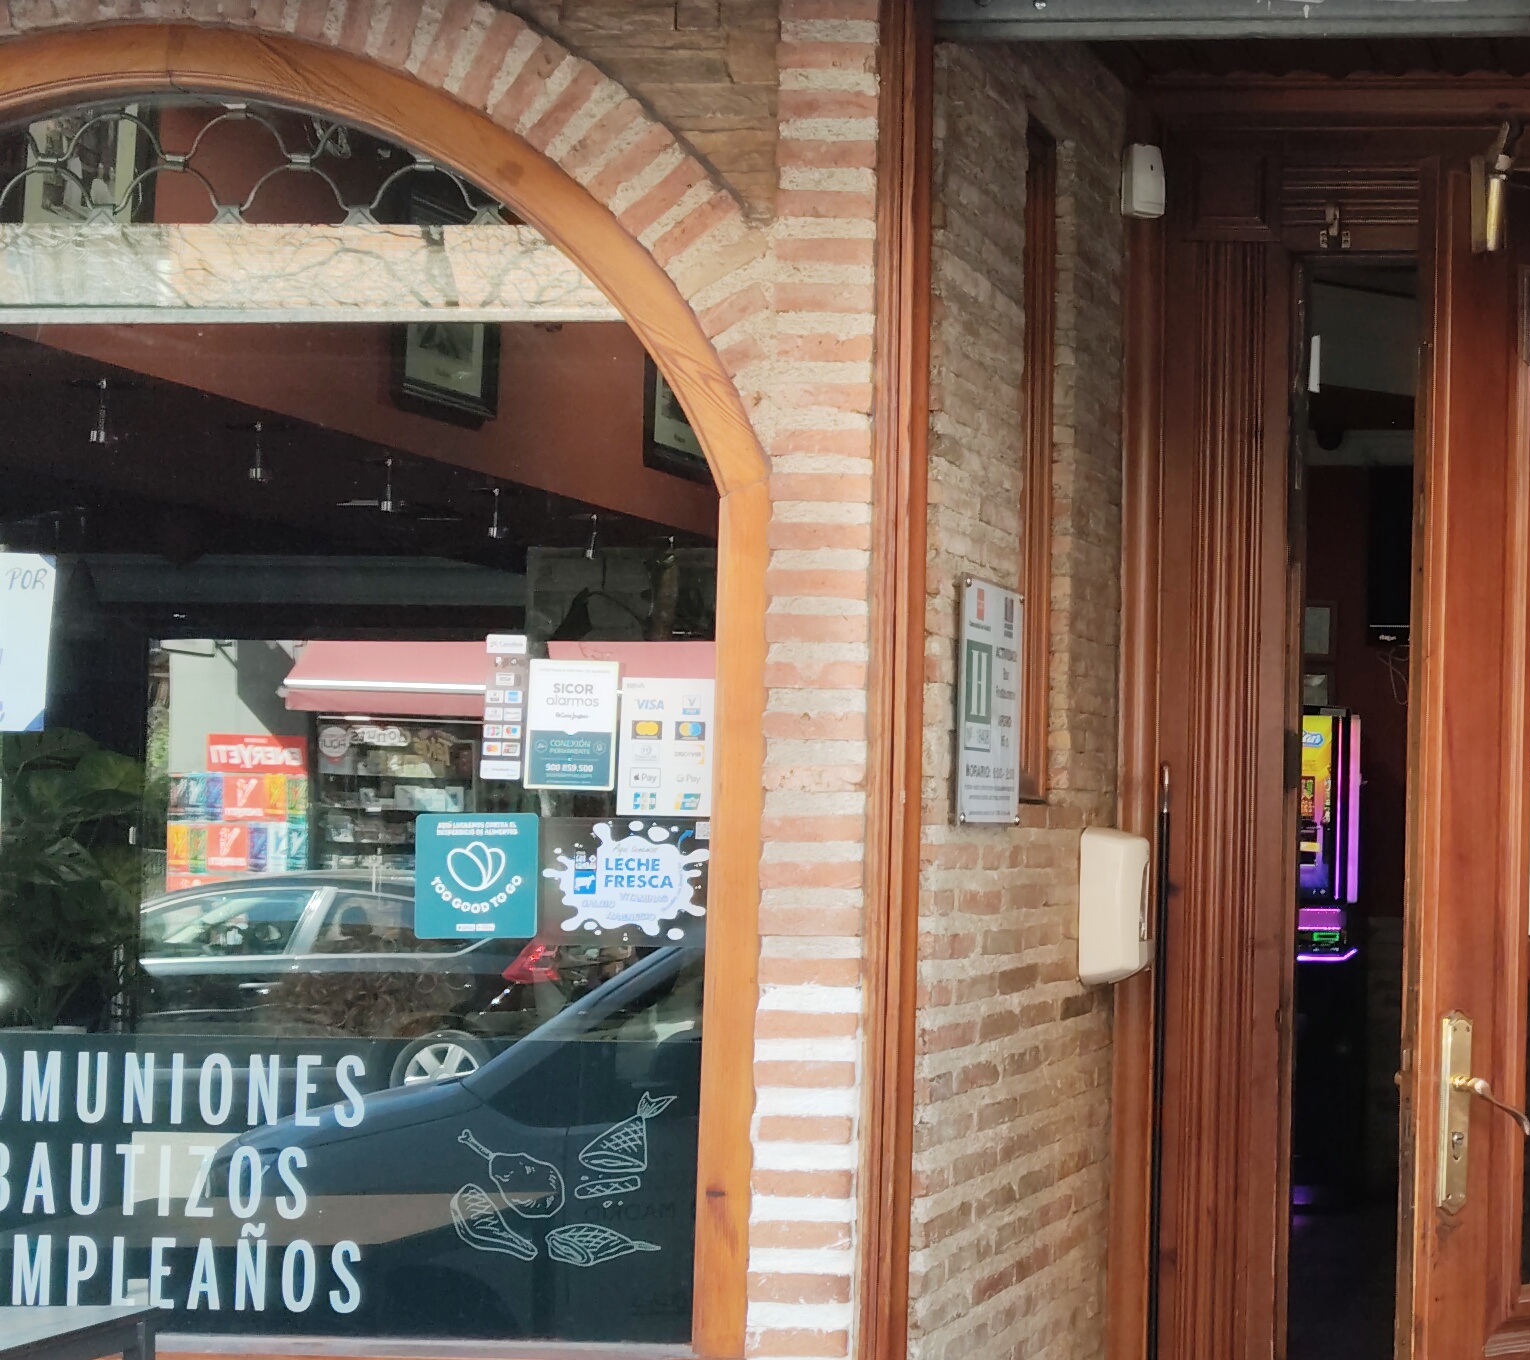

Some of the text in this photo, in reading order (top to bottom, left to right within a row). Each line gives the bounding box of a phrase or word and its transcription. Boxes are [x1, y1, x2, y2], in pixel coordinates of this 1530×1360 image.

[6, 567, 48, 591] POR
[553, 682, 594, 695] SICOR
[546, 695, 600, 707] alarmas
[636, 698, 665, 711] VISA
[604, 857, 662, 871] LECHE
[603, 874, 674, 889] FRESCA
[430, 875, 522, 914] TOO GOOD TO GO
[0, 1051, 366, 1128] MUNIONES
